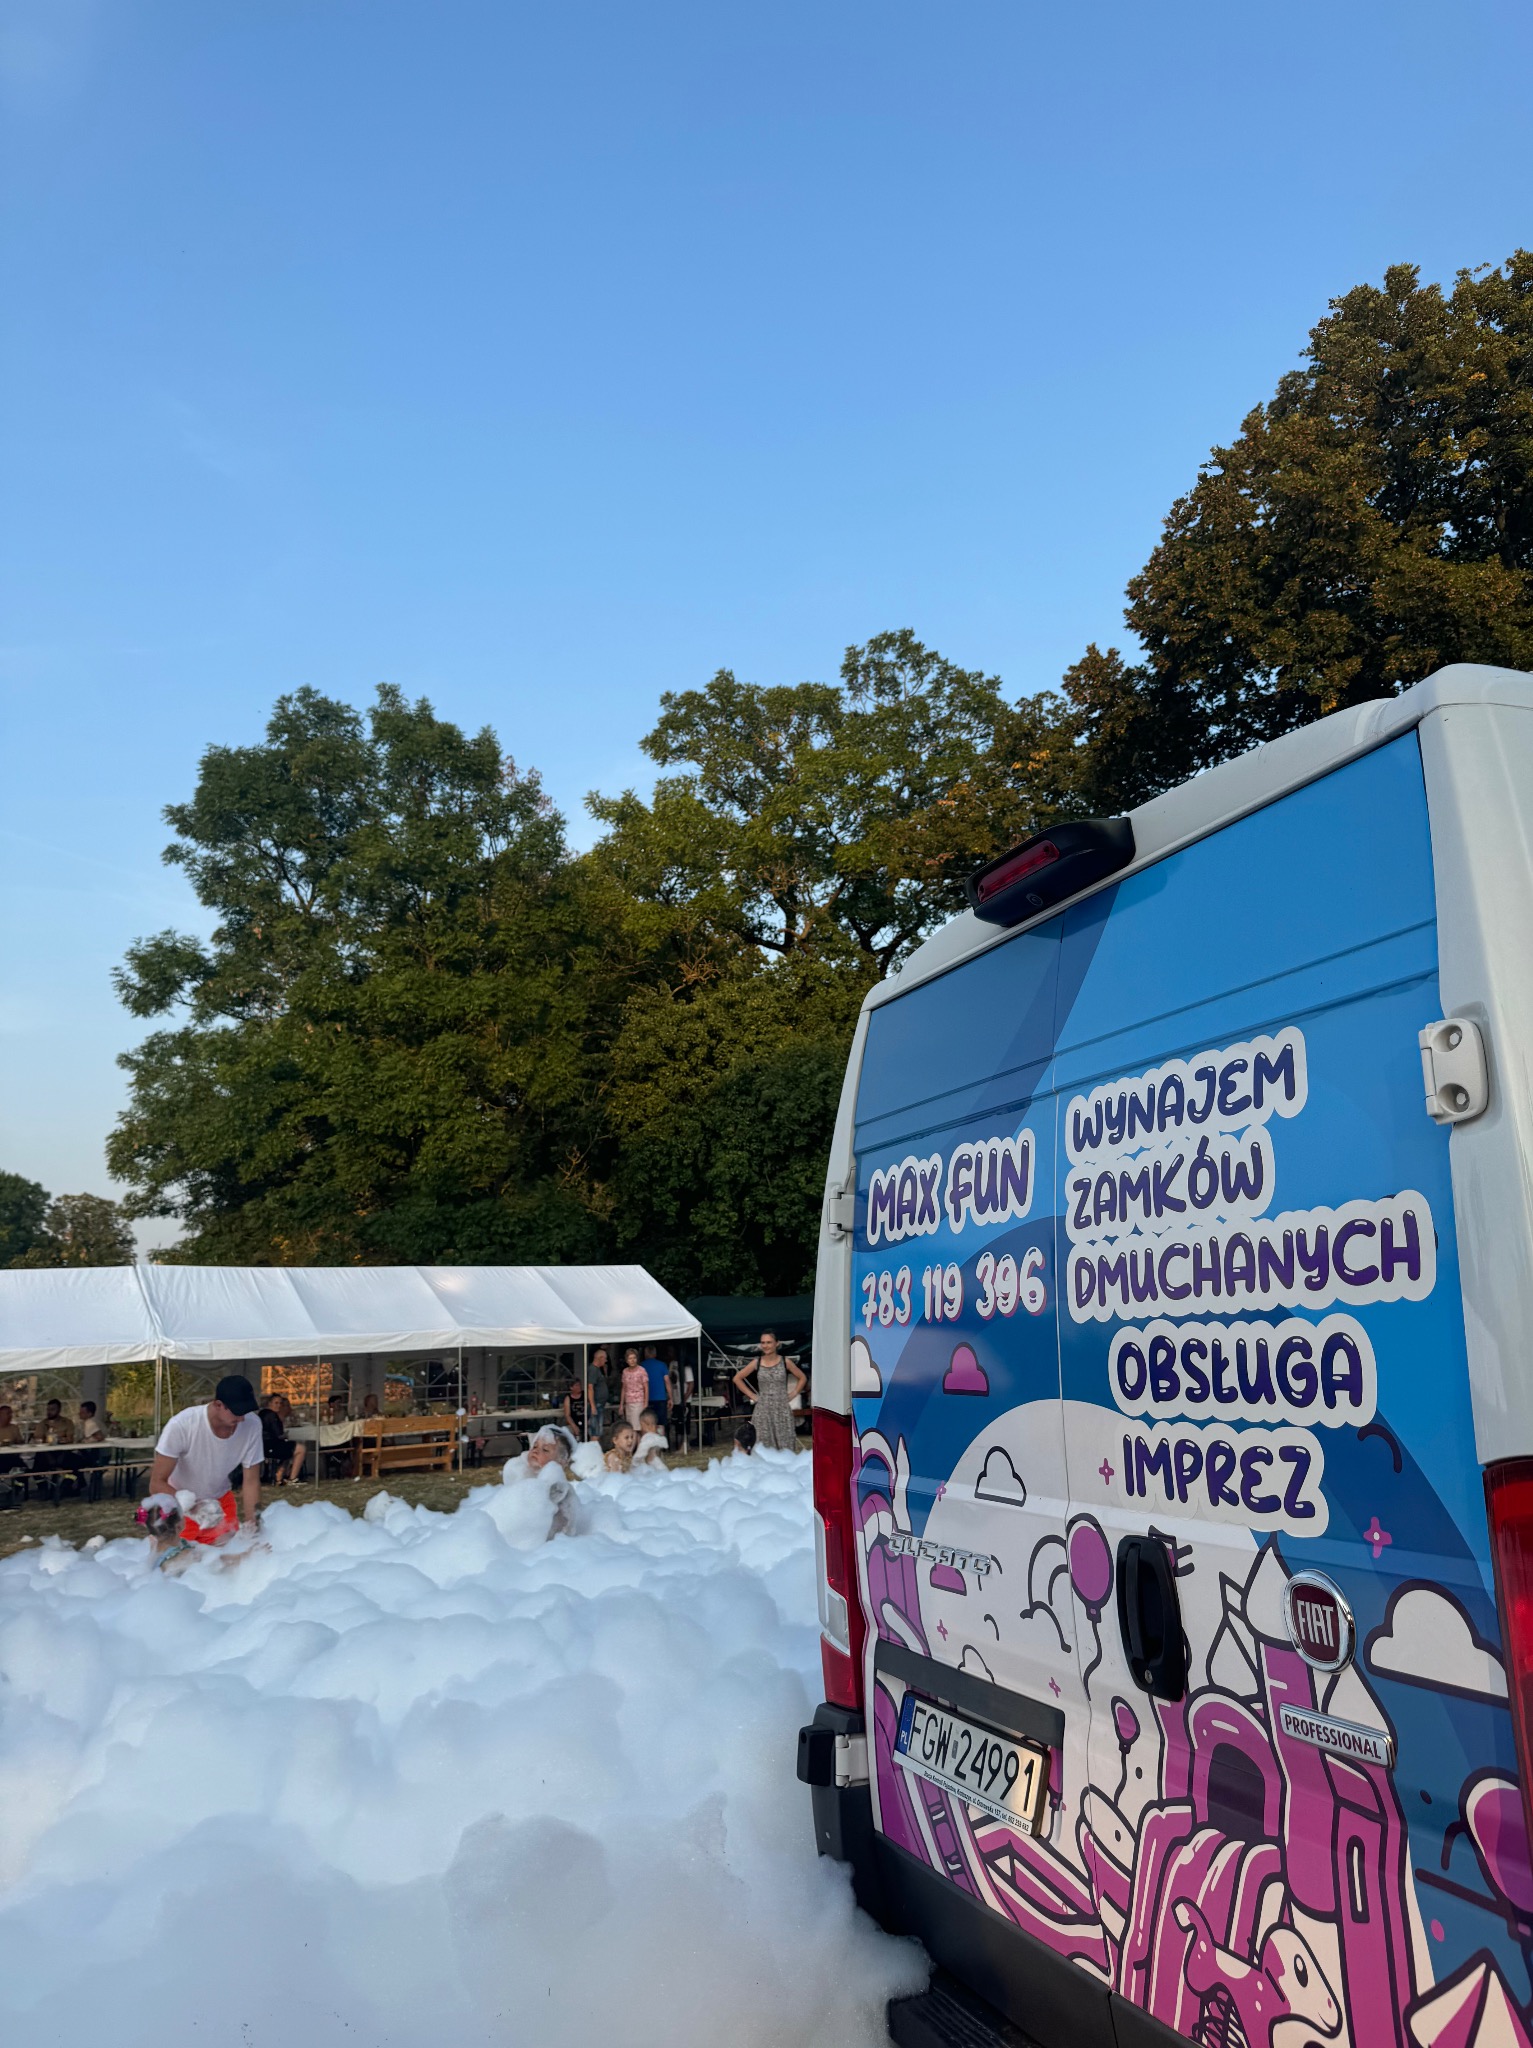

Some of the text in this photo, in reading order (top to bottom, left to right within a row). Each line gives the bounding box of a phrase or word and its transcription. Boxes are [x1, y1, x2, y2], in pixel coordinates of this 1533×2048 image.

[1073, 1043, 1296, 1153] WYNAJEM
[871, 1139, 1030, 1236] MAX FUN
[1073, 1134, 1264, 1230] ZAMKÓW
[862, 1246, 1046, 1328] 783 119 396
[1074, 1209, 1421, 1308] DMUCHANYCH
[1117, 1332, 1363, 1410] OBSŁUGA
[1122, 1434, 1316, 1519] IMPREZ
[1297, 1599, 1334, 1648] FIAT
[899, 1705, 1035, 1813] PL FGW 24991
[1284, 1714, 1382, 1760] PROFESSIONAL
